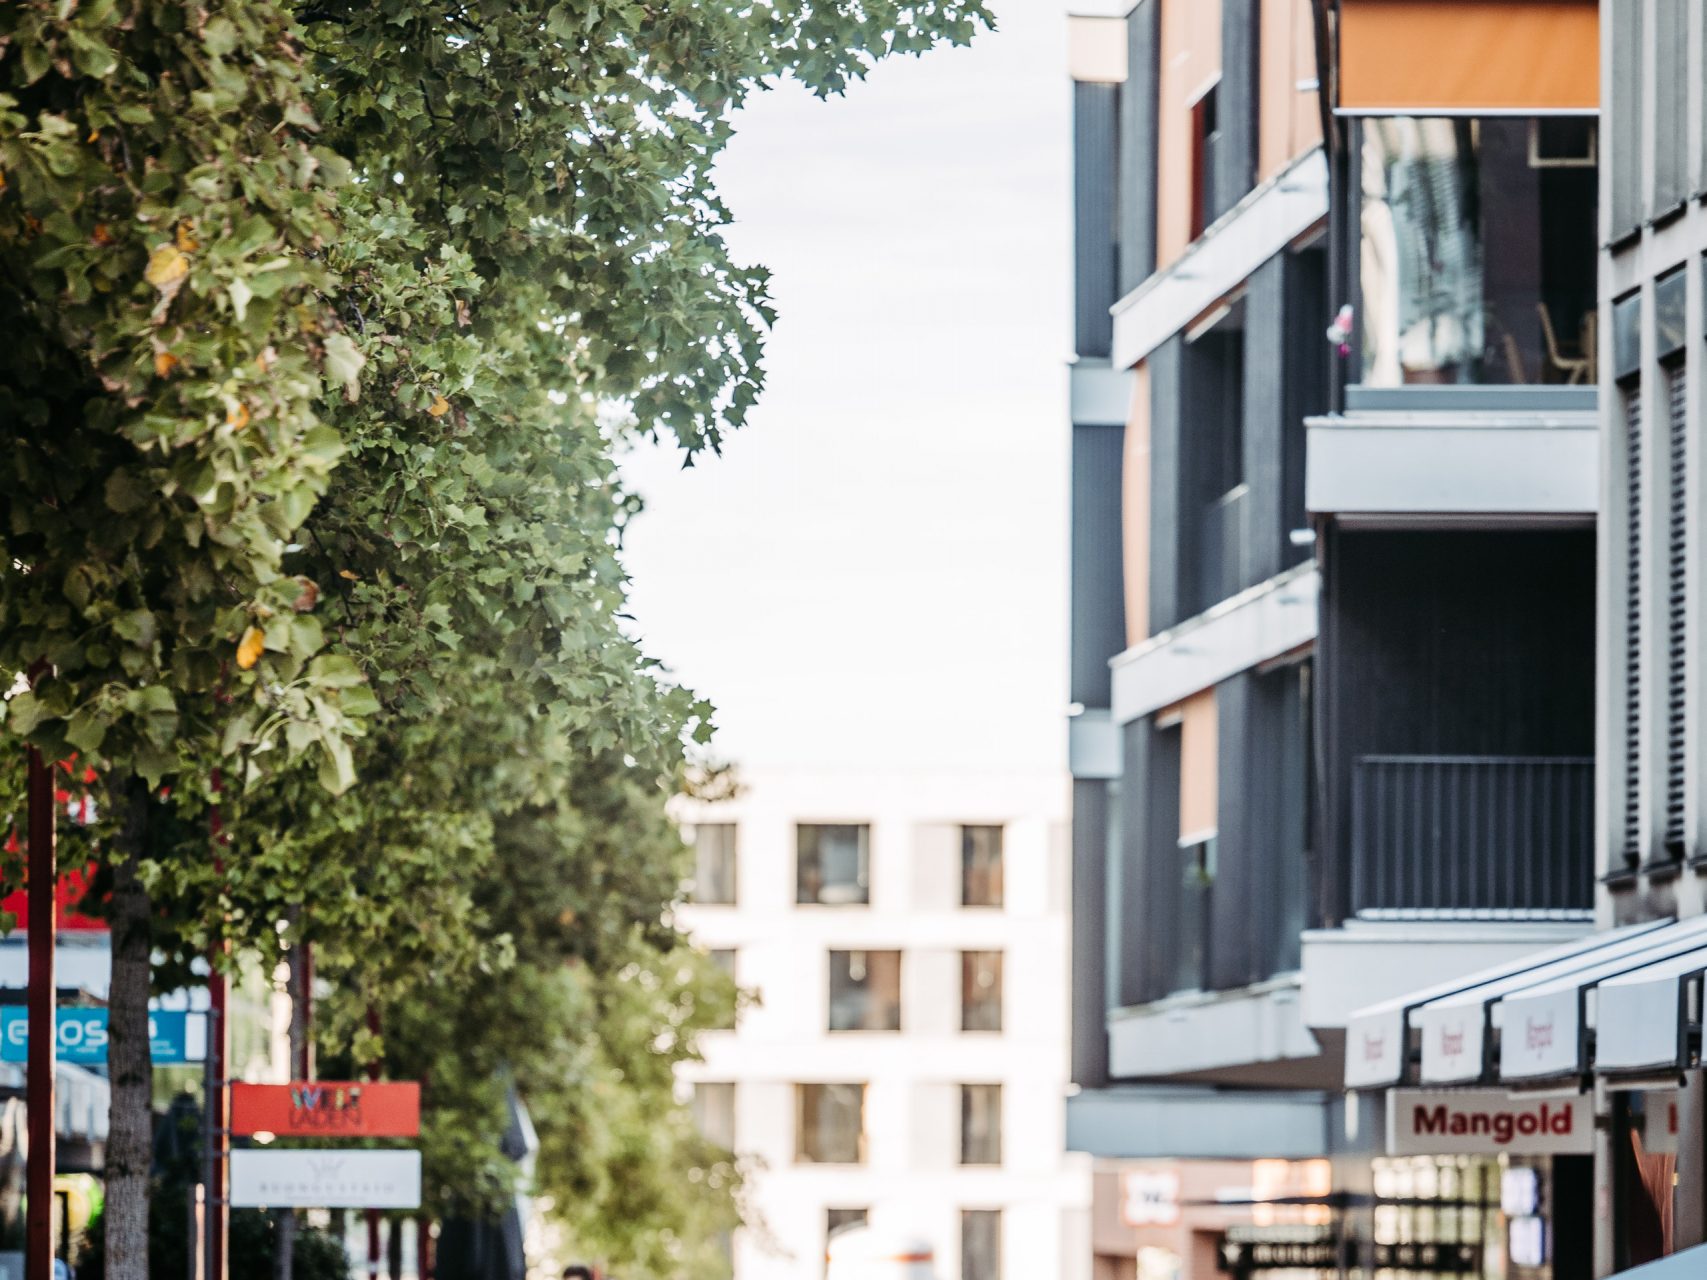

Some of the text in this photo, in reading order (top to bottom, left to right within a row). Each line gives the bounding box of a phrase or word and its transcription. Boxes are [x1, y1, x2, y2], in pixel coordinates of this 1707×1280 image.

[8, 1019, 109, 1046] eos
[290, 1087, 361, 1110] WELT
[1413, 1102, 1573, 1144] Mangold
